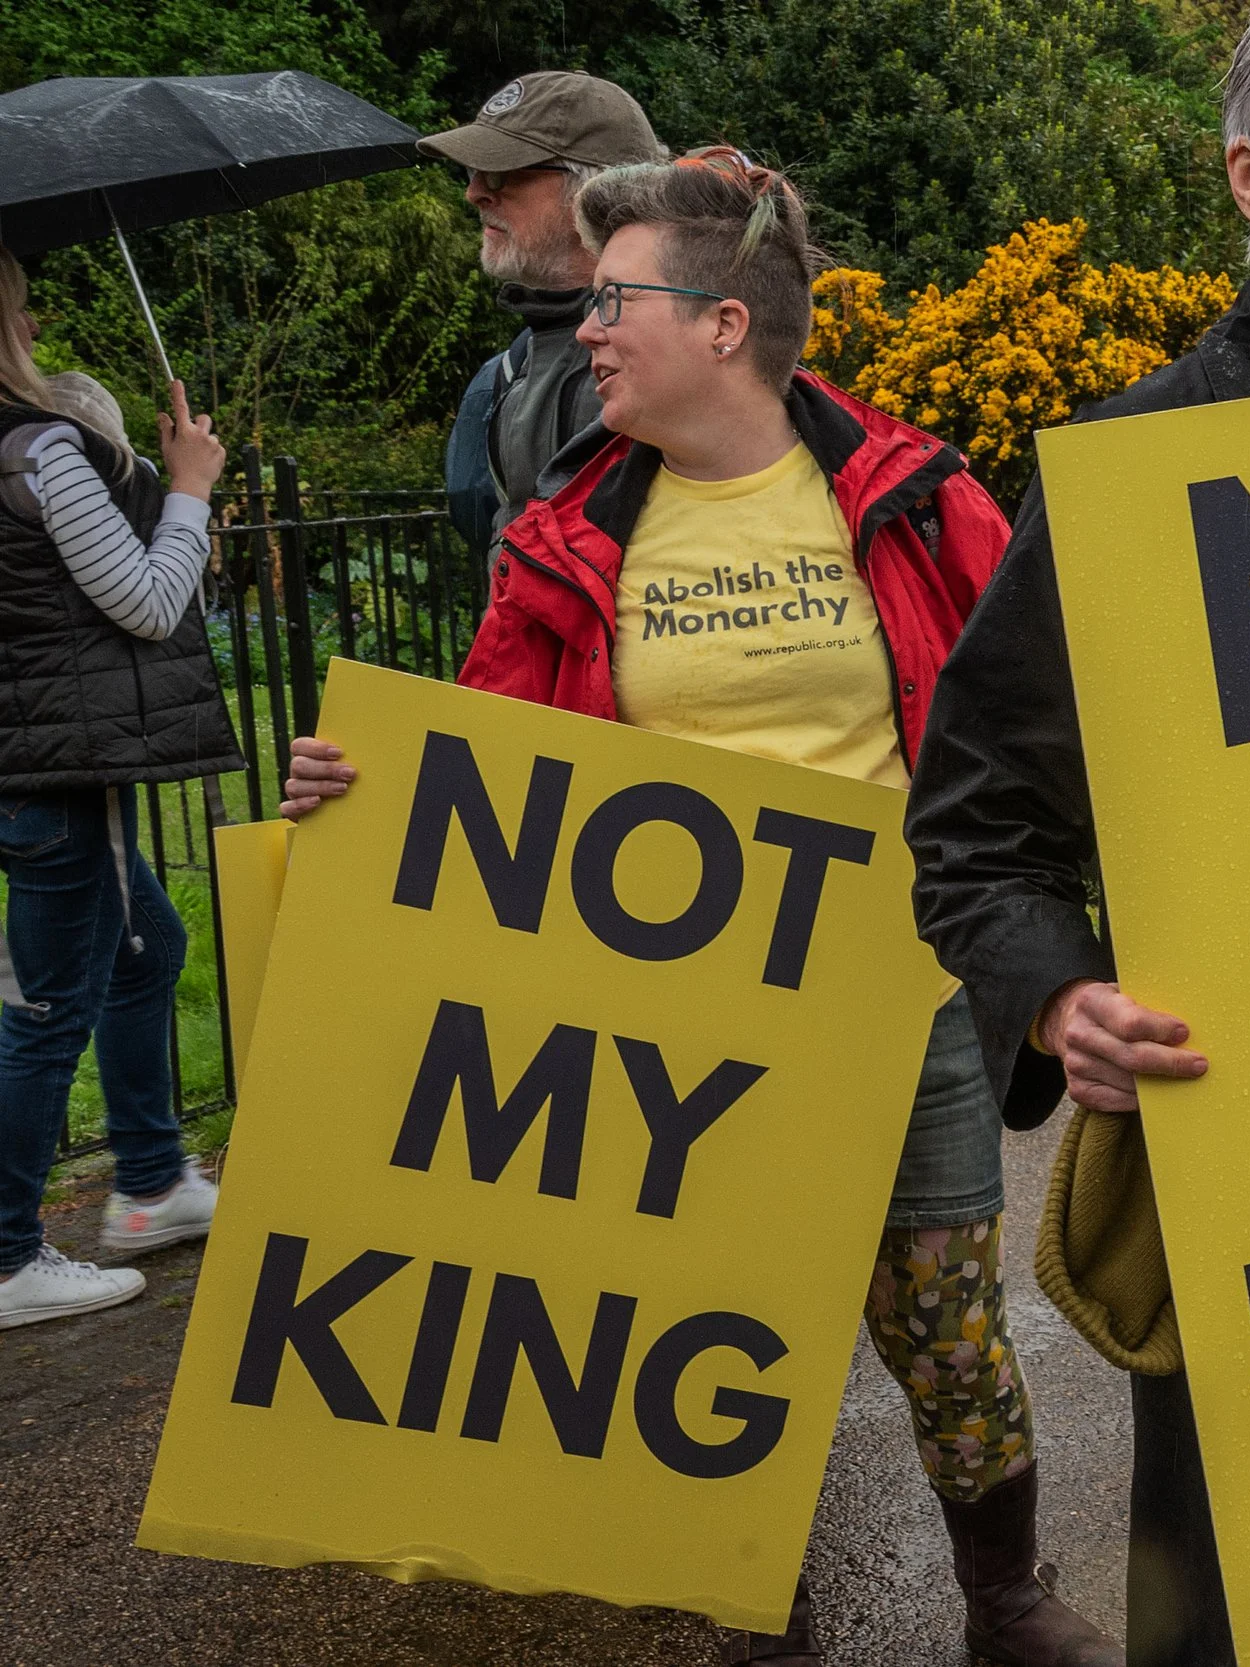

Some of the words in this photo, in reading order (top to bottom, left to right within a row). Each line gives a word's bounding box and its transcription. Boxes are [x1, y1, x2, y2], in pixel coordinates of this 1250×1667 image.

[642, 562, 776, 606] Abolish
[785, 555, 844, 585] the
[642, 588, 849, 641] Monarchy
[744, 635, 863, 658] www.republic.org.uk
[392, 730, 876, 991] NOT
[389, 999, 770, 1219] MY
[230, 1232, 791, 1480] KING
